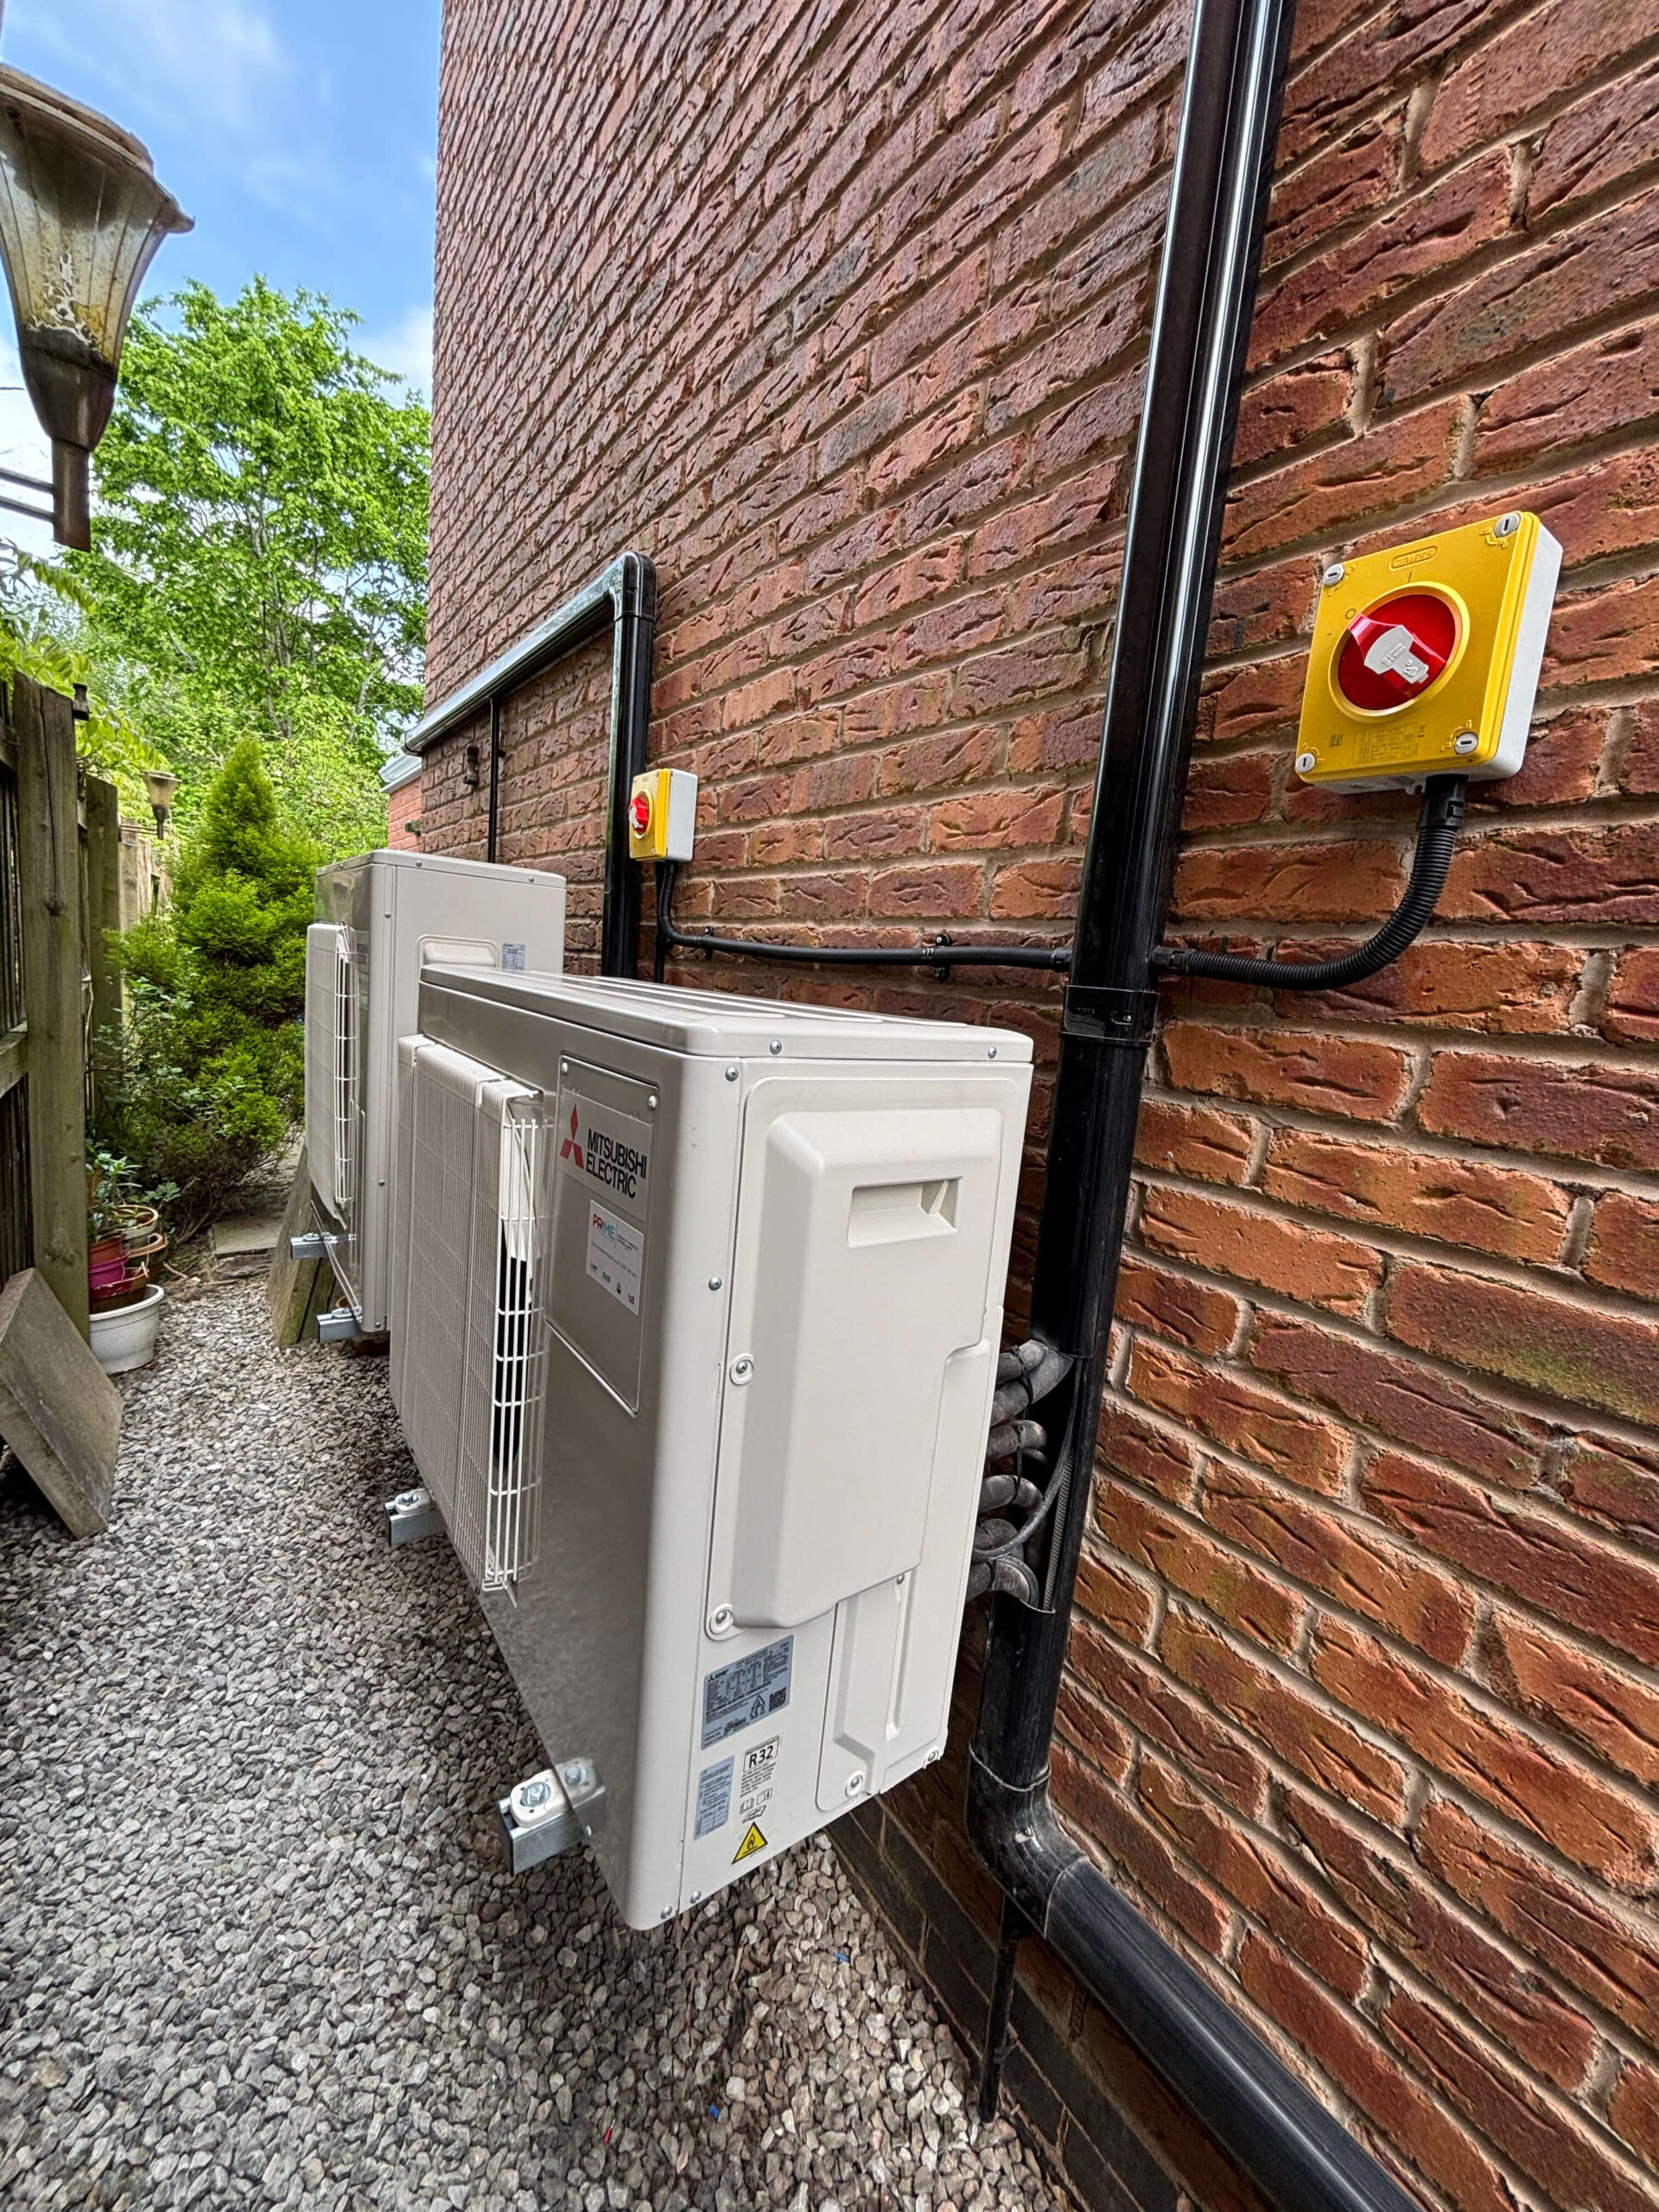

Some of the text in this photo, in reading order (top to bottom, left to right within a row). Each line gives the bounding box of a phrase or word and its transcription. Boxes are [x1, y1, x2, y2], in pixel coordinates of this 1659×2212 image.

[588, 1128, 647, 1179] MITSUBISHI
[586, 1153, 636, 1199] ELECTRIC
[592, 1213, 615, 1241] PRIME
[748, 1745, 774, 1769] R32
